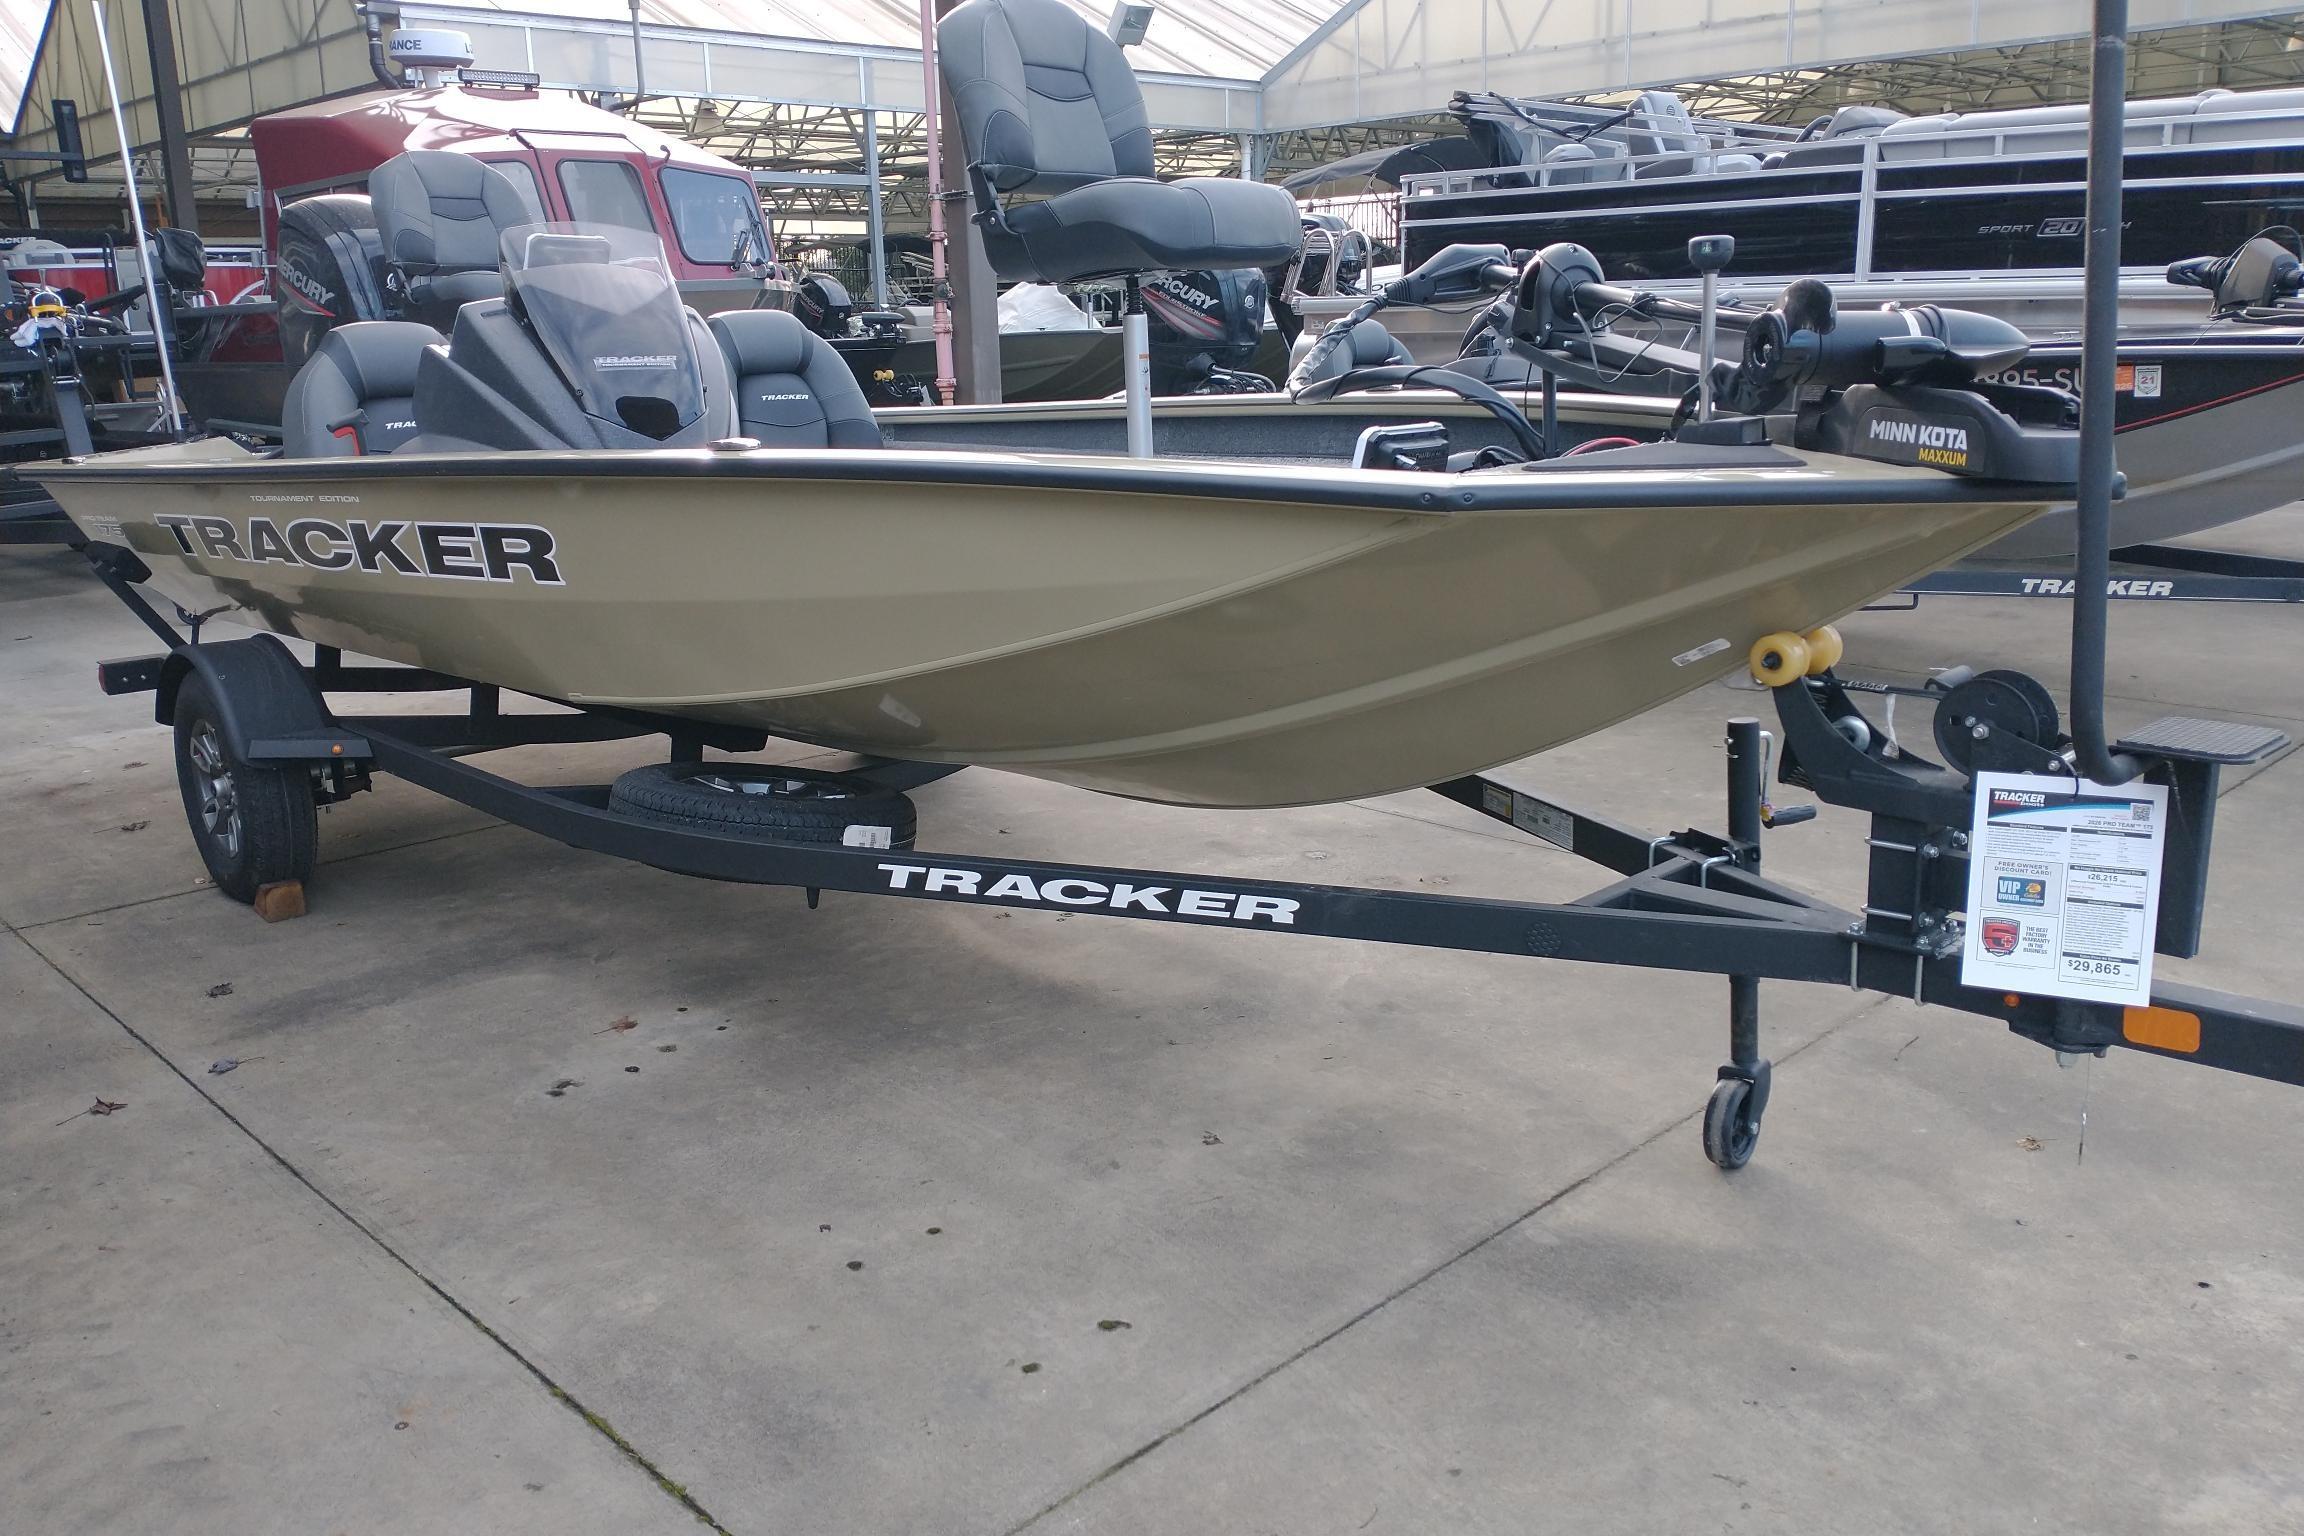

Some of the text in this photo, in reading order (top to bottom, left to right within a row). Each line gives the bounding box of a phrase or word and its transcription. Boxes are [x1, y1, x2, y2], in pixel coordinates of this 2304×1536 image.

[389, 39, 422, 51] ANCE
[1977, 220, 2078, 234] SPORT 20
[0, 236, 37, 245] ACKER
[279, 256, 336, 305] ERCURY
[1158, 274, 1220, 310] RCURY
[595, 355, 678, 364] TRACKER
[2140, 376, 2155, 385] 21
[385, 420, 417, 430] TRAC
[1869, 419, 1968, 450] MINN KOTA
[1918, 447, 1967, 466] MAXXUM
[249, 495, 360, 503] TOURNAMENT EDITION
[153, 513, 567, 587] TRACKER
[2022, 578, 2174, 596] TRAKER
[1994, 790, 2046, 804] TRACKER
[1994, 866, 2029, 874] DISCOUNT
[2017, 862, 2049, 870] OWNER'S
[2088, 873, 2118, 882] $26,215
[877, 862, 1301, 925] TRACKER
[1999, 879, 2021, 894] VIP
[1998, 893, 2020, 902] OWNER
[2067, 959, 2121, 976] $29,865
